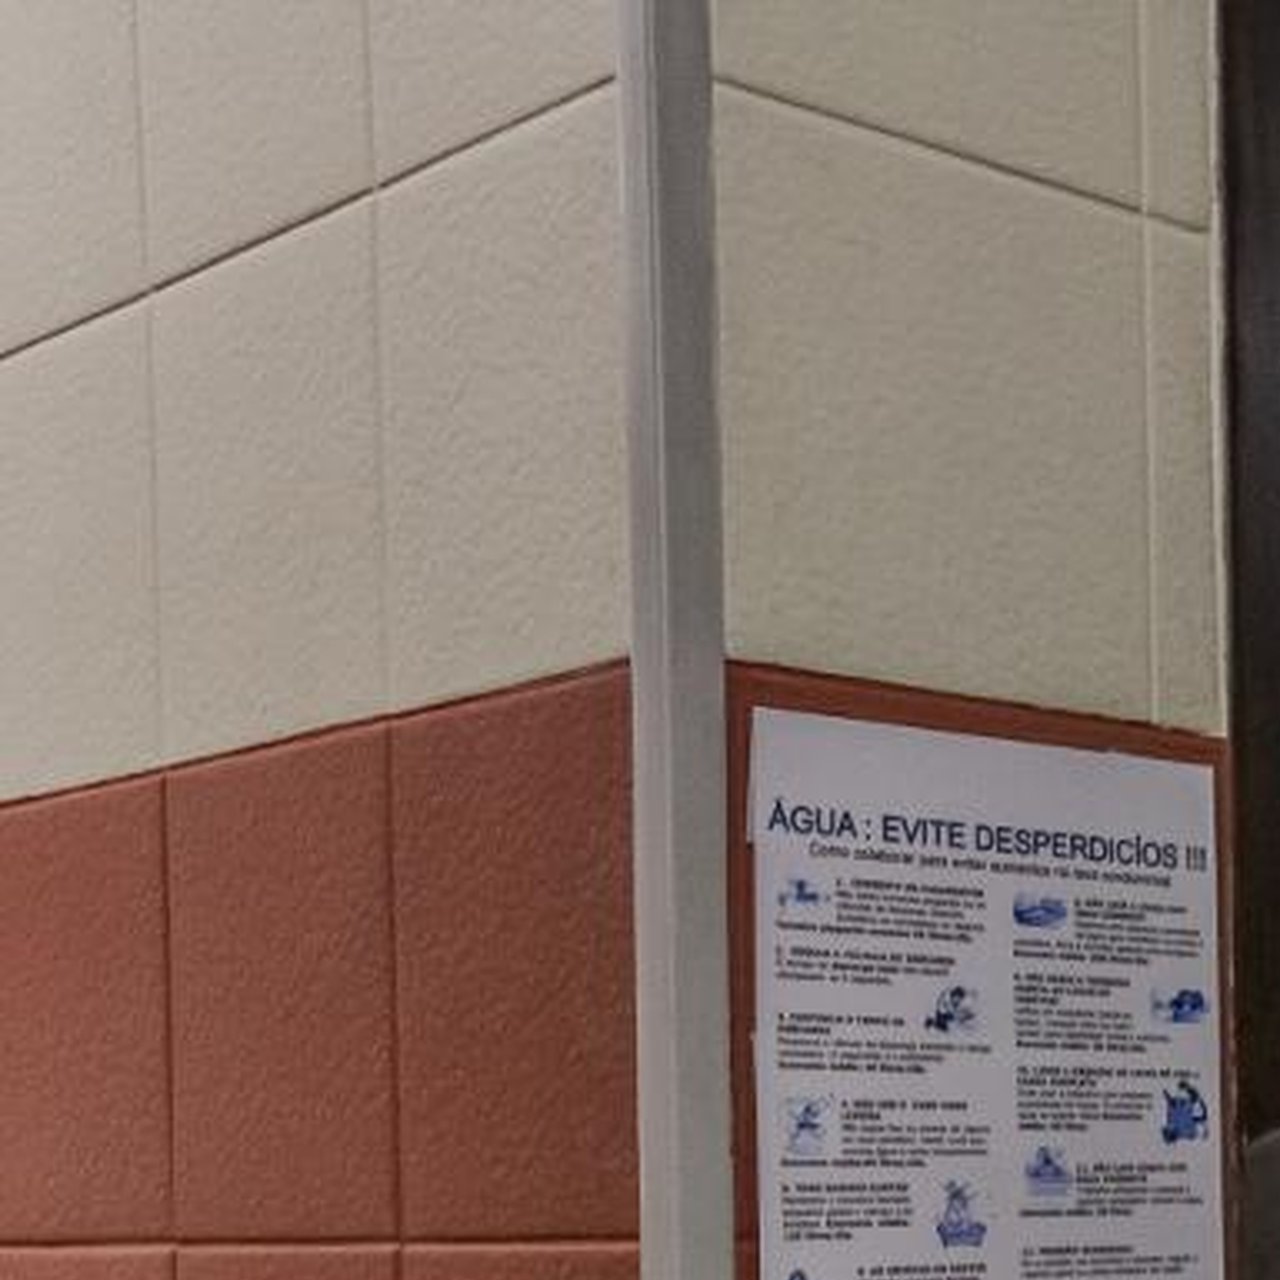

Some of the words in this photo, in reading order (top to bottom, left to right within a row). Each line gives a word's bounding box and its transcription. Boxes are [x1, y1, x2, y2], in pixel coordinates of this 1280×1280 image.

[768, 797, 857, 839] ÁGUA
[882, 814, 966, 850] EVITE
[809, 841, 849, 858] Como
